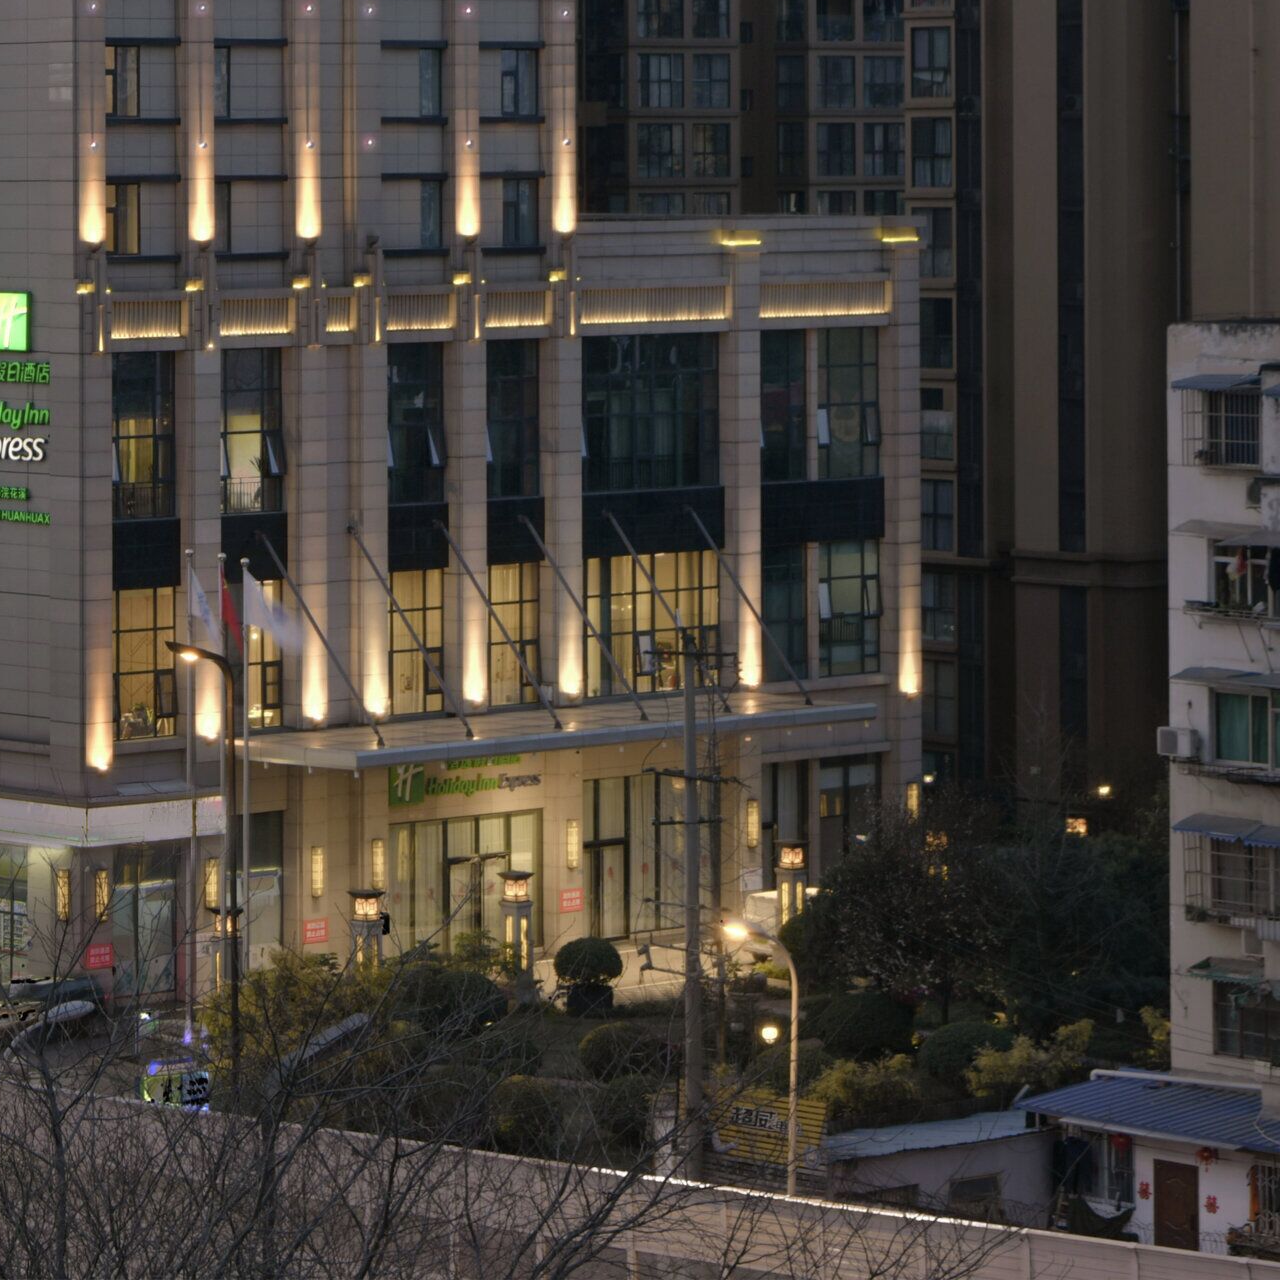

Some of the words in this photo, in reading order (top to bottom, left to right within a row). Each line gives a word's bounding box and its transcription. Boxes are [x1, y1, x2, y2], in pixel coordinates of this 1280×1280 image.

[24, 401, 50, 425] Inn
[427, 775, 478, 797] Holiday
[477, 773, 499, 791] Inn
[498, 772, 542, 792] Express
